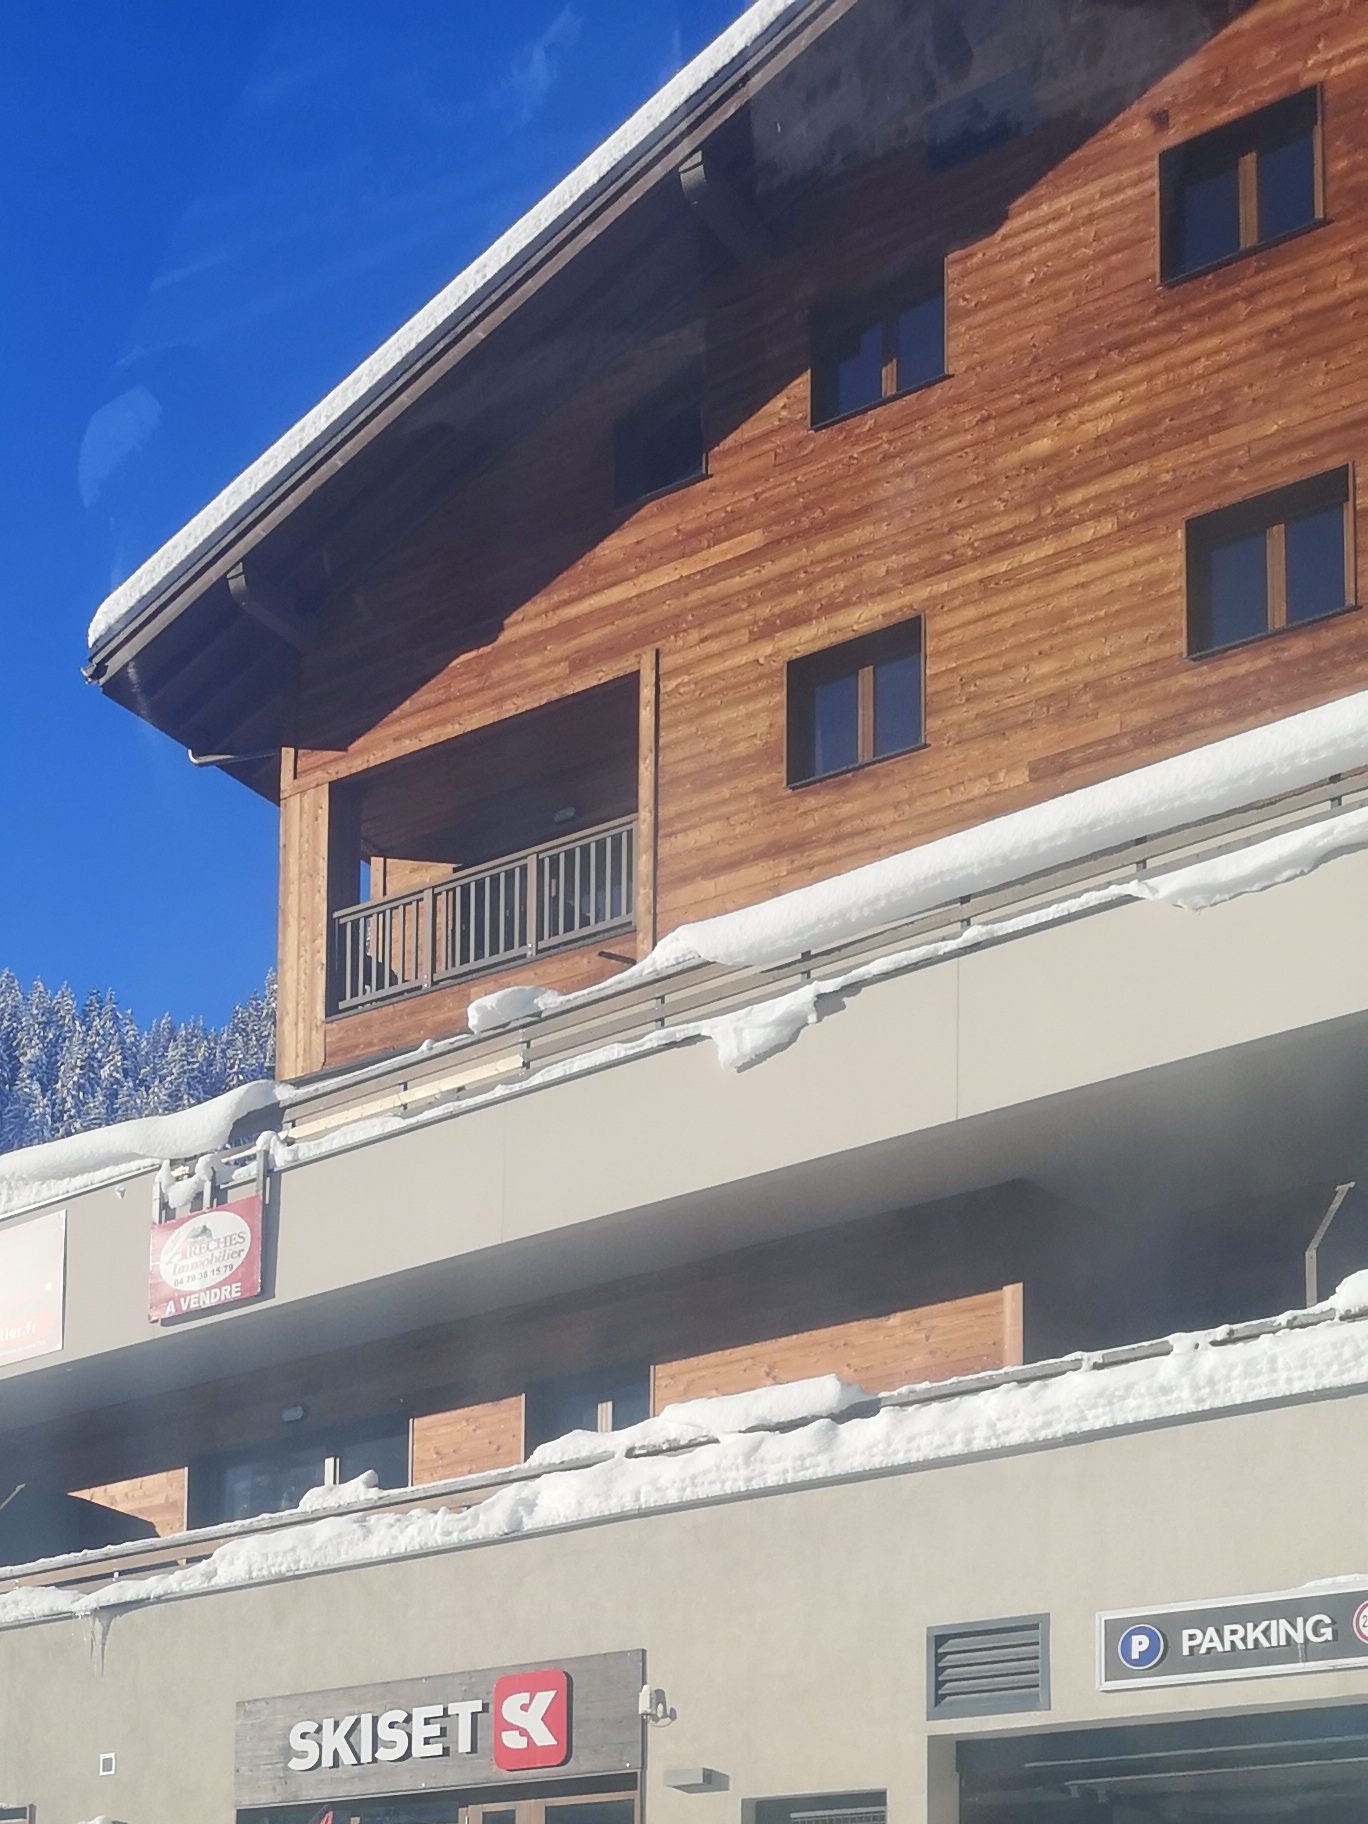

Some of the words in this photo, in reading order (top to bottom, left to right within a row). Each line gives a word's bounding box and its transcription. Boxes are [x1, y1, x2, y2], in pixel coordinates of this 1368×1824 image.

[172, 1247, 245, 1276] Immobilier
[224, 1263, 233, 1273] 79
[166, 1301, 175, 1315] A
[179, 1282, 241, 1311] VENDRE
[1131, 1634, 1150, 1660] P
[1181, 1614, 1333, 1656] PARKING
[287, 1699, 483, 1771] SKISET
